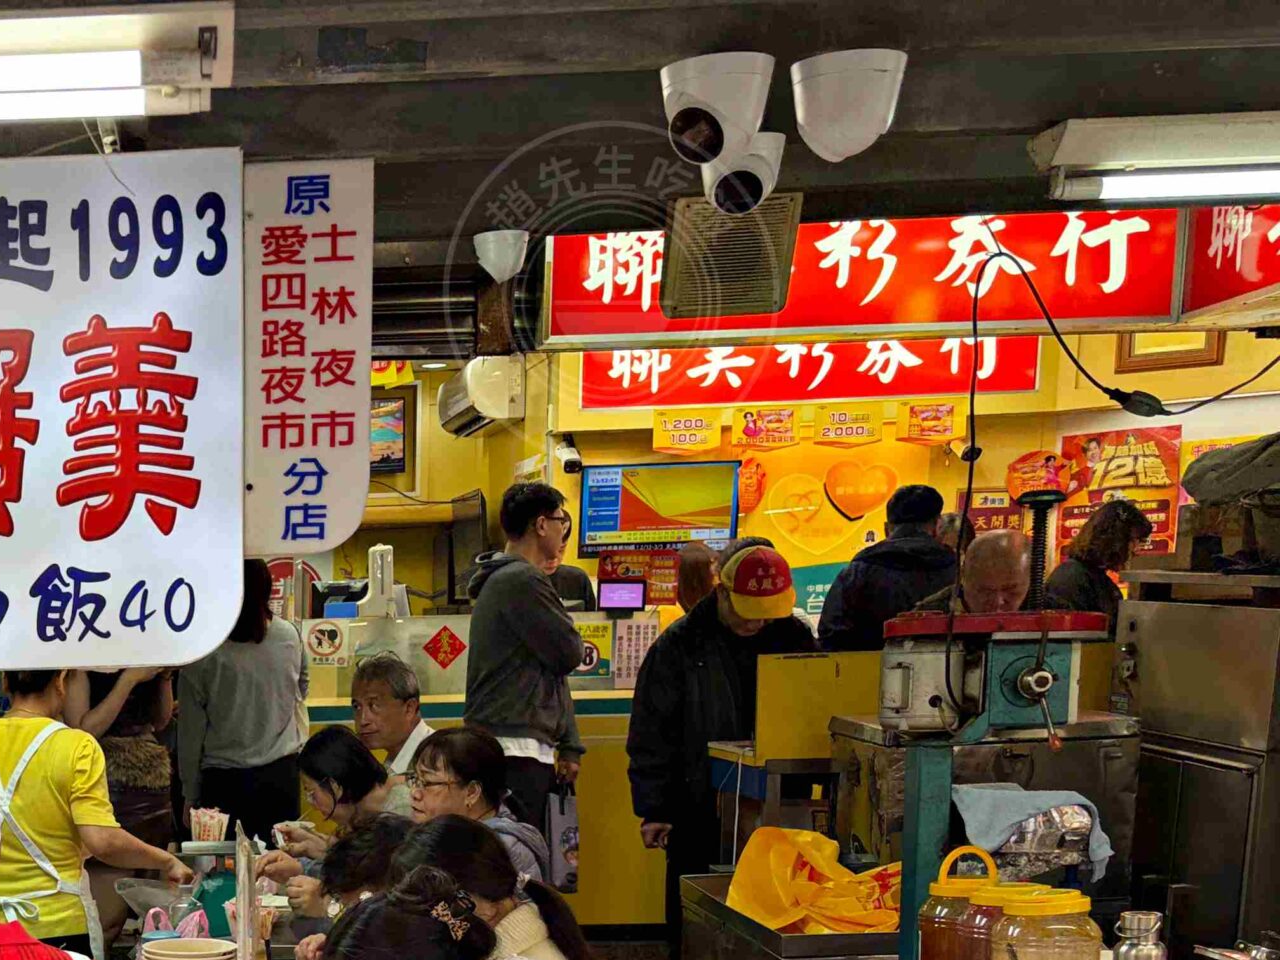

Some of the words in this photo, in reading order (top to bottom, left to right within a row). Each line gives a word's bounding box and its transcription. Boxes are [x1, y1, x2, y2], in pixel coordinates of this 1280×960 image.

[285, 174, 331, 215] 原
[261, 225, 308, 450] 愛四路夜市
[310, 223, 357, 448] 士林夜市
[281, 457, 328, 541] 分店
